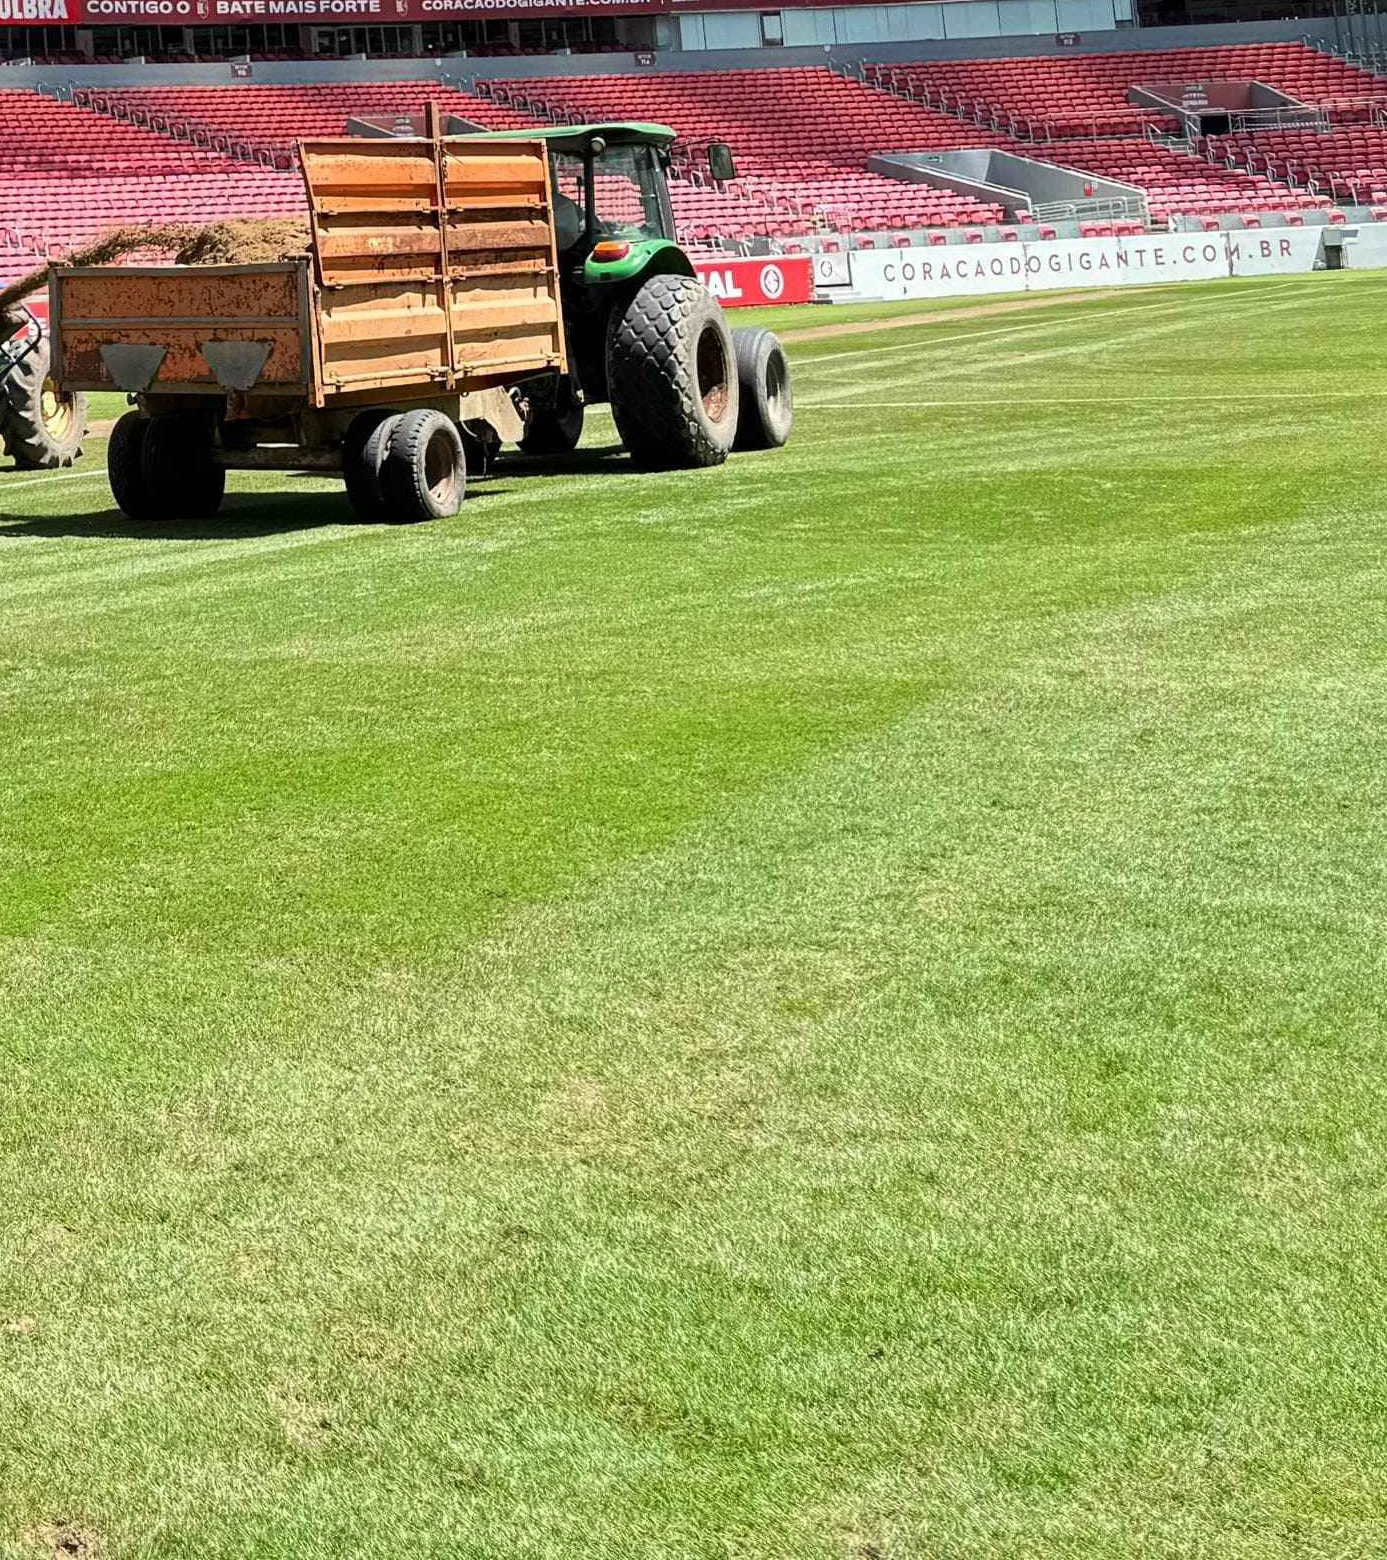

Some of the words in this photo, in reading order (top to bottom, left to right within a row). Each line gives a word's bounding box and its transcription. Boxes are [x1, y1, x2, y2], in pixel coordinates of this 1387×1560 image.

[86, 0, 174, 15] CONTIGO
[176, 0, 191, 15] O
[216, 0, 266, 14] BATE
[268, 0, 317, 14] MAIS
[319, 0, 381, 14] FORTE
